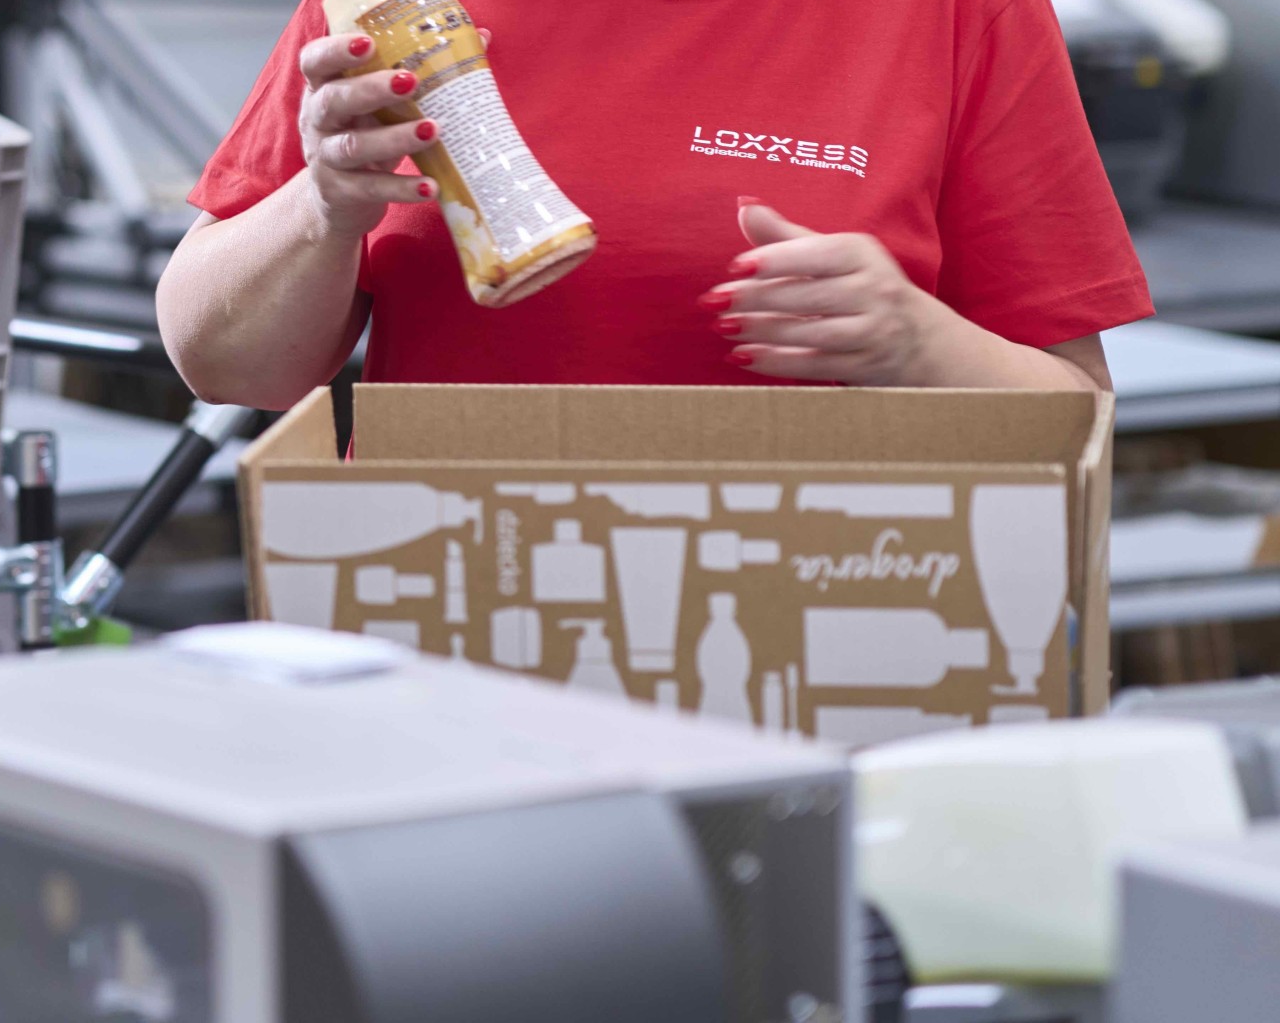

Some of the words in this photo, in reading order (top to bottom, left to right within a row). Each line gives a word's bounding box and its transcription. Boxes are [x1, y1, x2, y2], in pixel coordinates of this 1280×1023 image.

[690, 144, 758, 159] logistics
[766, 153, 781, 162] &
[693, 126, 869, 167] LOXXESS
[790, 528, 960, 599] drogeria
